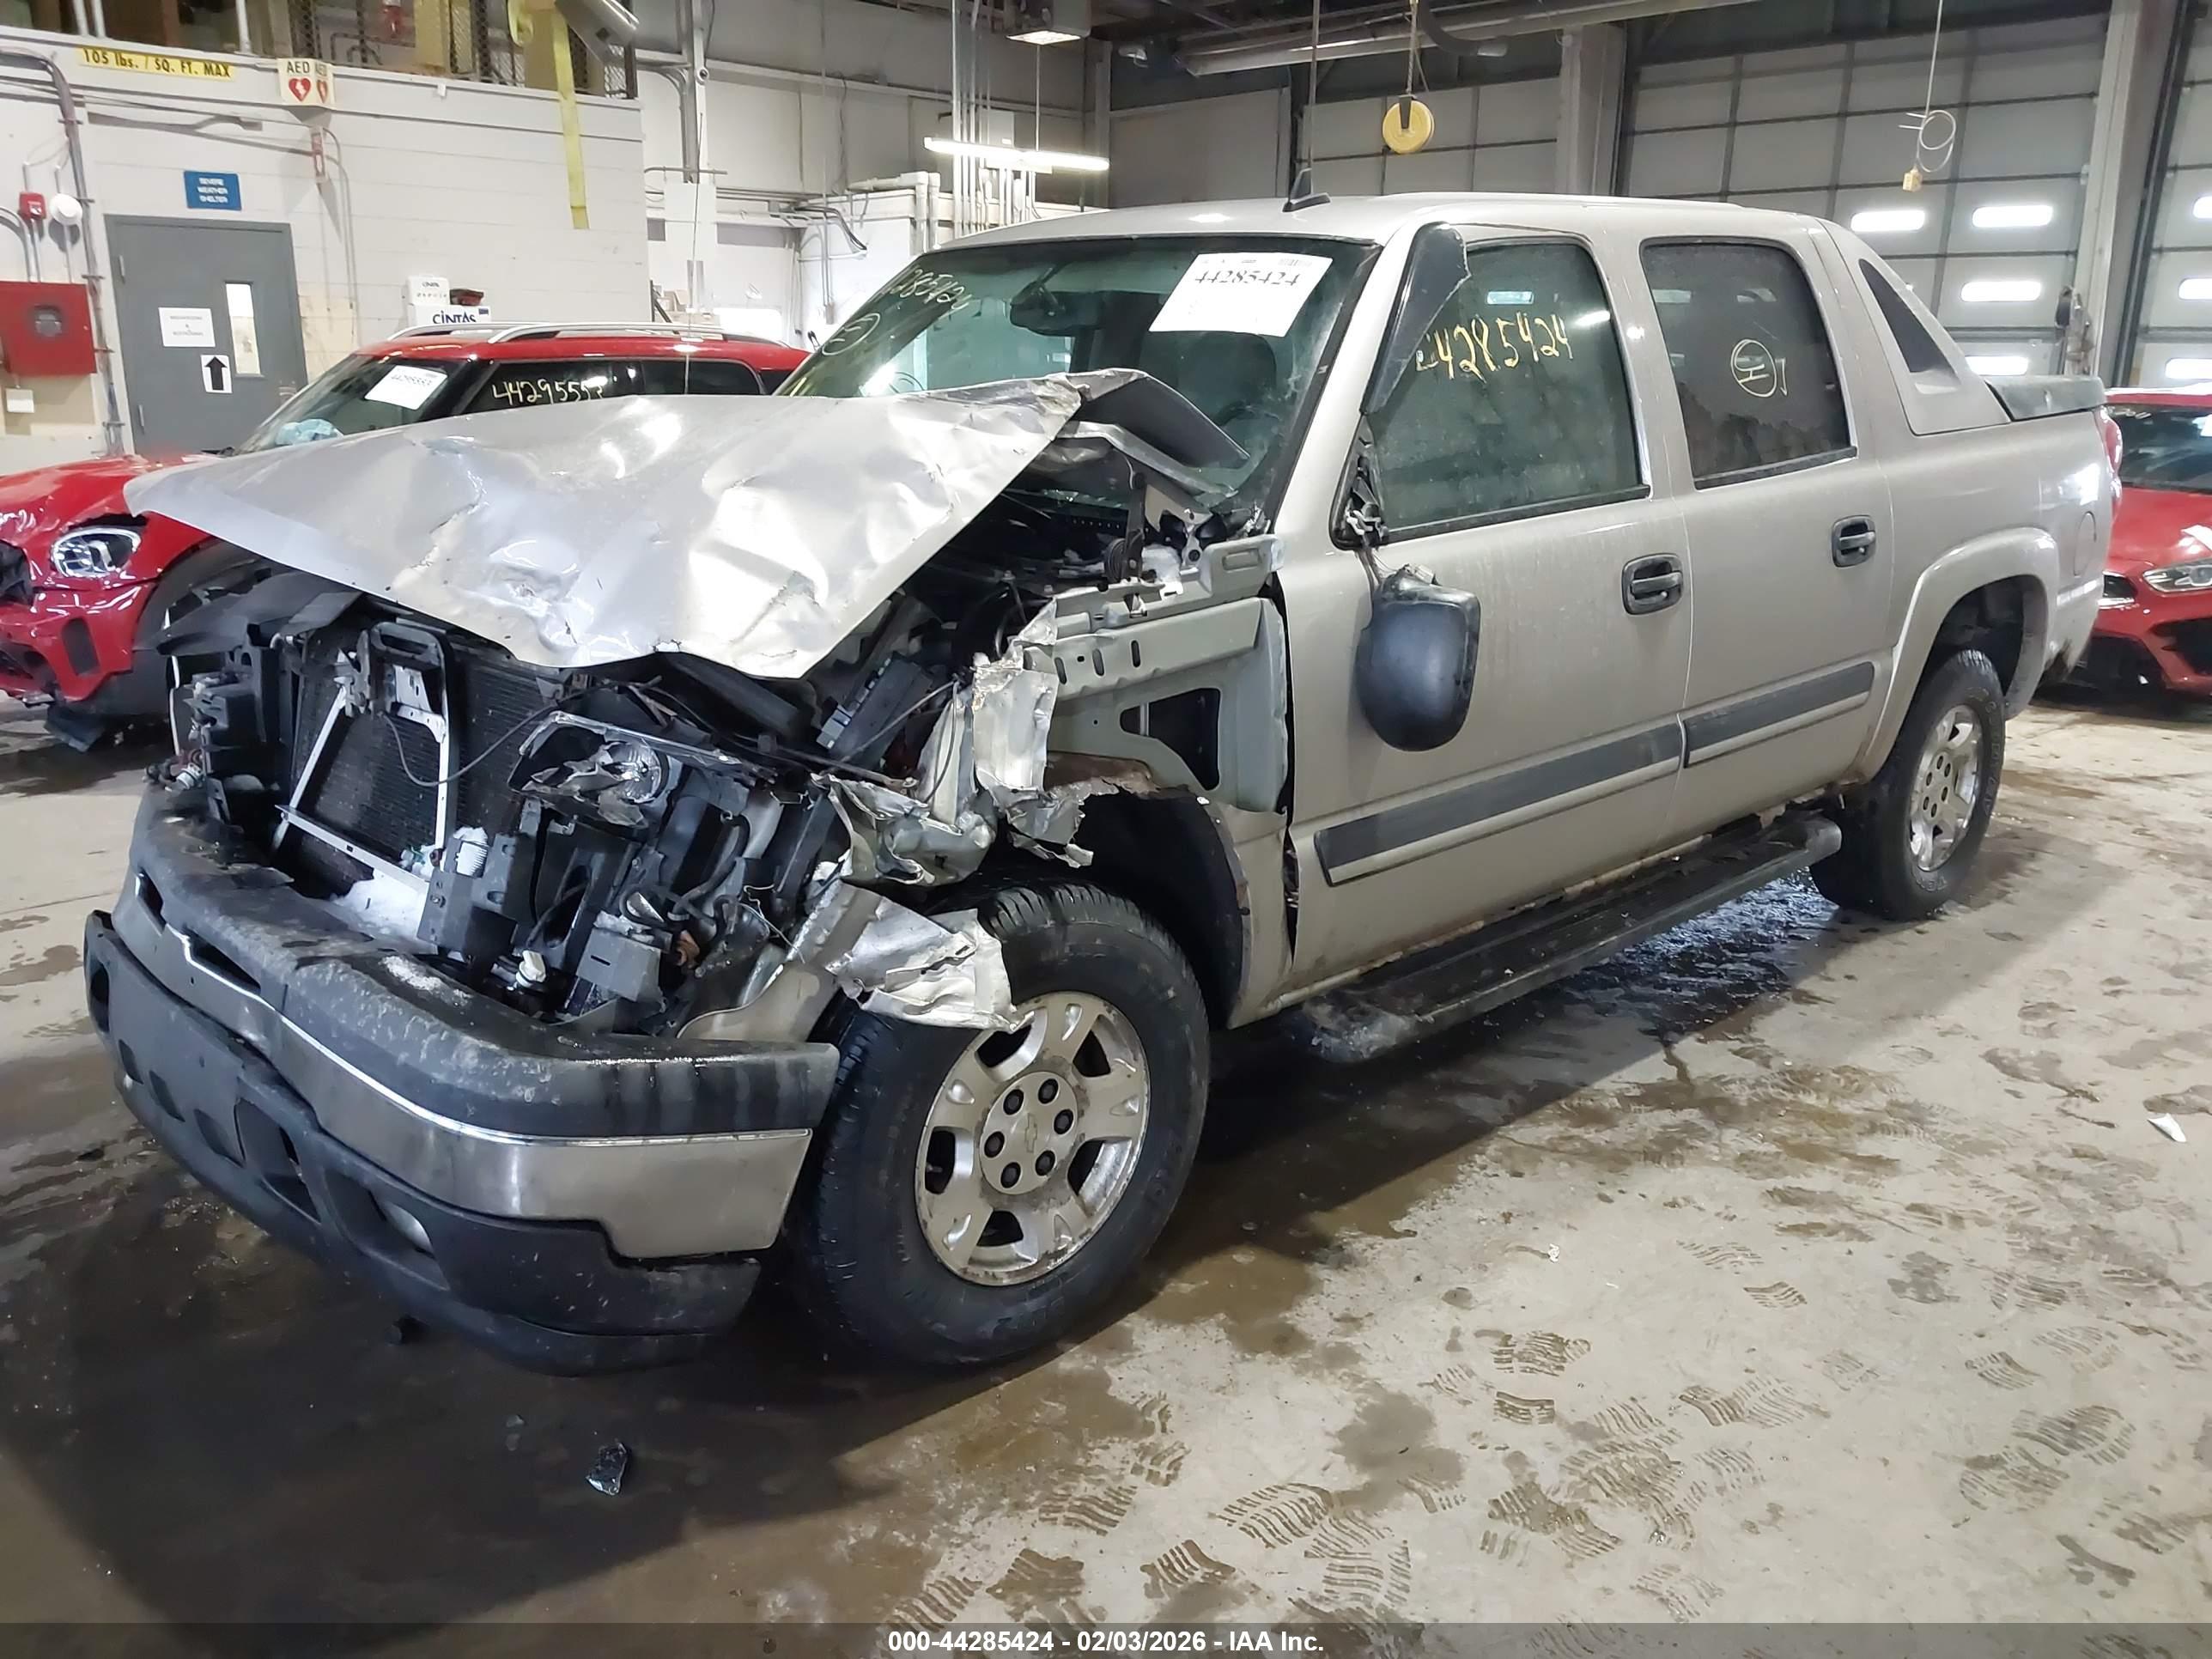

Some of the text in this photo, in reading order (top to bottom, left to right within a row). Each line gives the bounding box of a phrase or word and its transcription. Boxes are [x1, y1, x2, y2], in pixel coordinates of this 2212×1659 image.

[83, 49, 230, 78] 105 lbs. / SQ. FT. MAX
[287, 61, 310, 73] AED
[1194, 270, 1301, 286] 44285424
[432, 310, 477, 325] CINTAS
